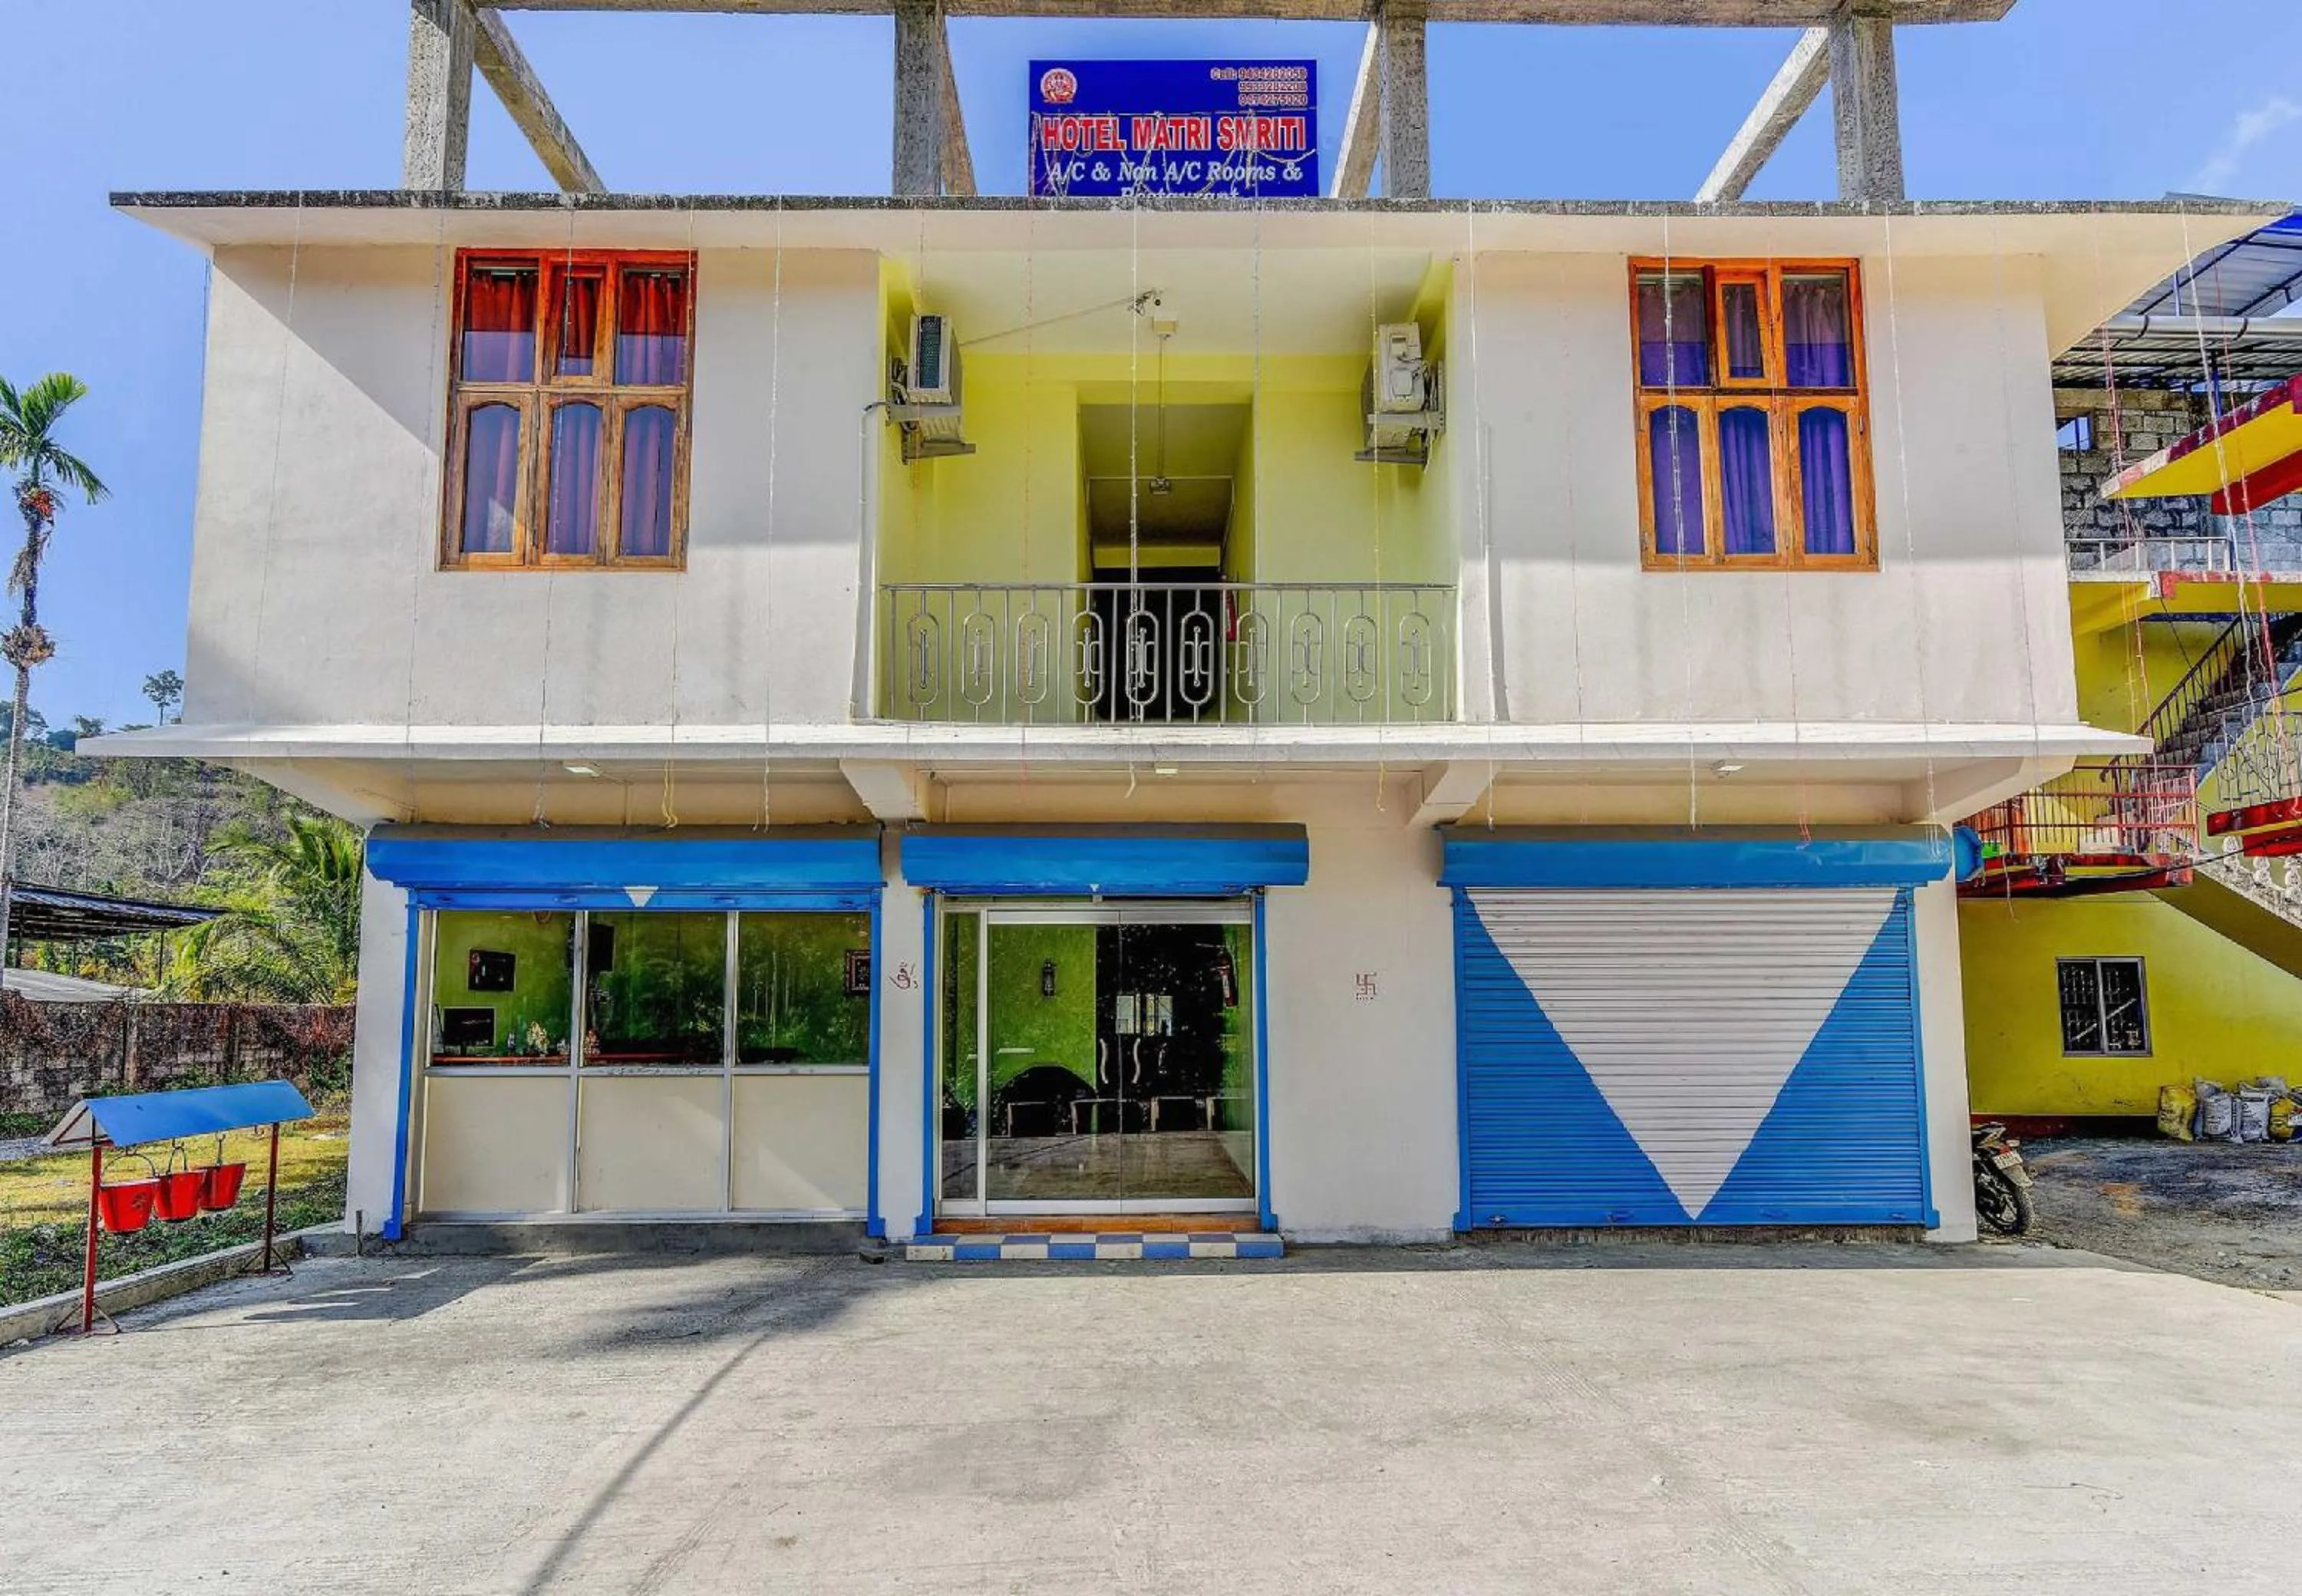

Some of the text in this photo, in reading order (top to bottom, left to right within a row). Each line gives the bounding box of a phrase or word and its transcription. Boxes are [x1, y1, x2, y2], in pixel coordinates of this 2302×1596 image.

[1042, 117, 1306, 151] HOTEL MATRI SMRITI
[1049, 161, 1304, 185] A/C & Non A/C Rooms &
